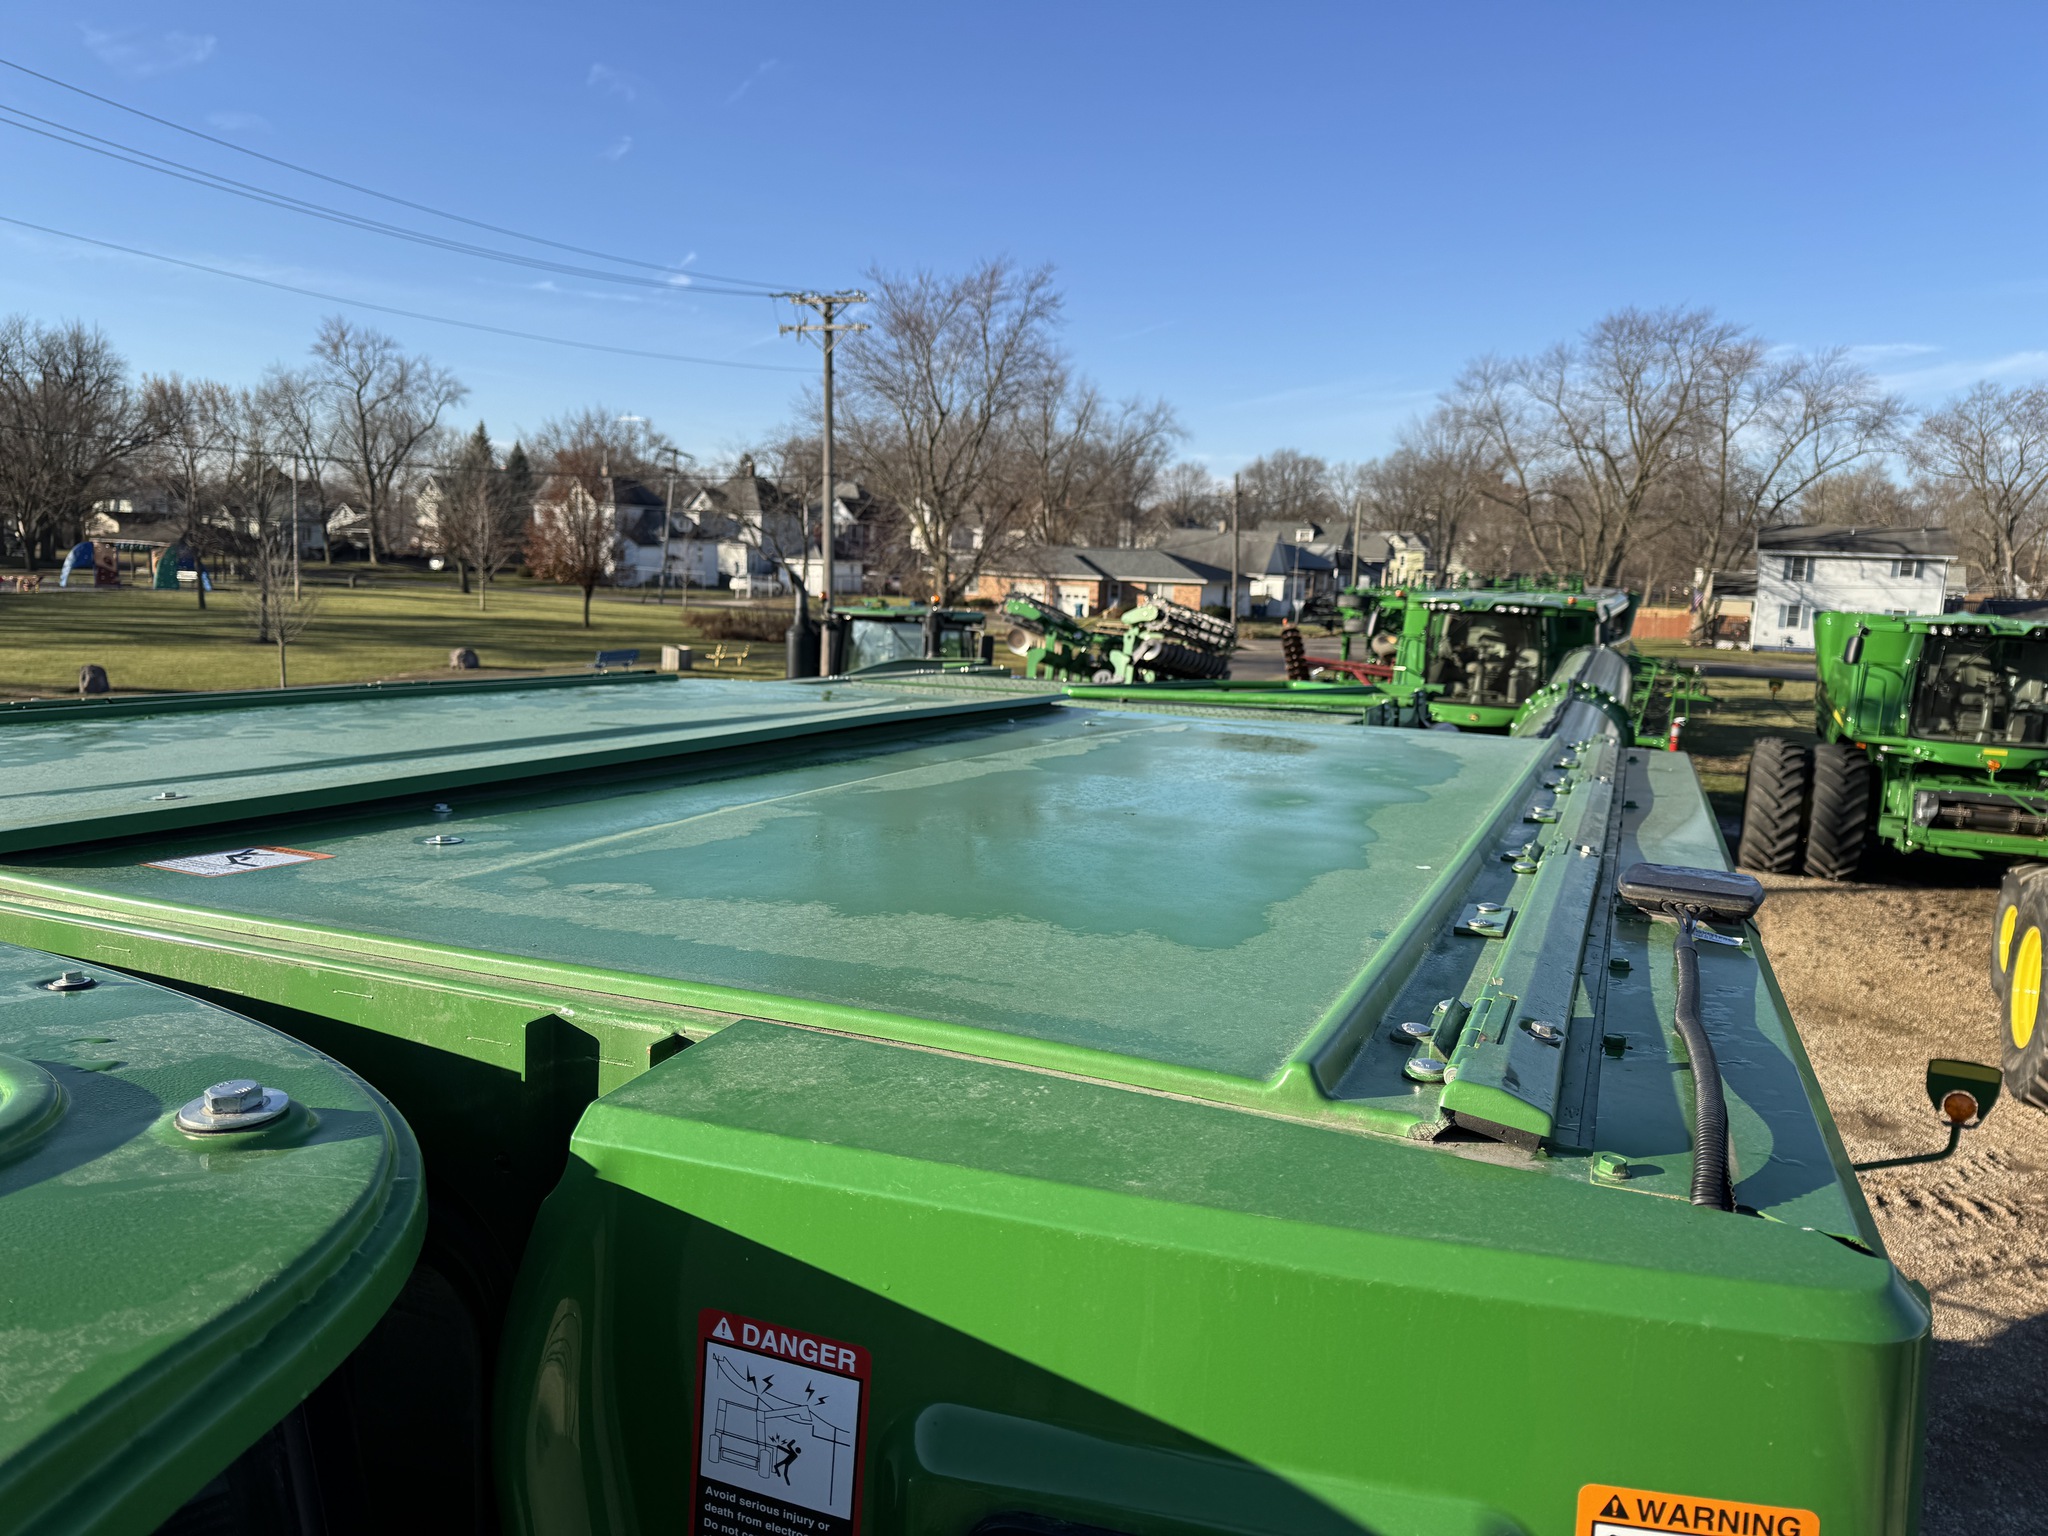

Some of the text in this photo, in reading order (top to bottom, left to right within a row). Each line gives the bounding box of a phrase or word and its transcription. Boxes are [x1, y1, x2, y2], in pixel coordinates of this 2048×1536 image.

[742, 1323, 857, 1373] DANGER
[703, 1517, 719, 1530] Do
[721, 1525, 739, 1536] not
[704, 1502, 734, 1519] death
[737, 1511, 762, 1528] from
[705, 1485, 831, 1531] Avoid serious injury or
[1636, 1498, 1801, 1536] WARNING
